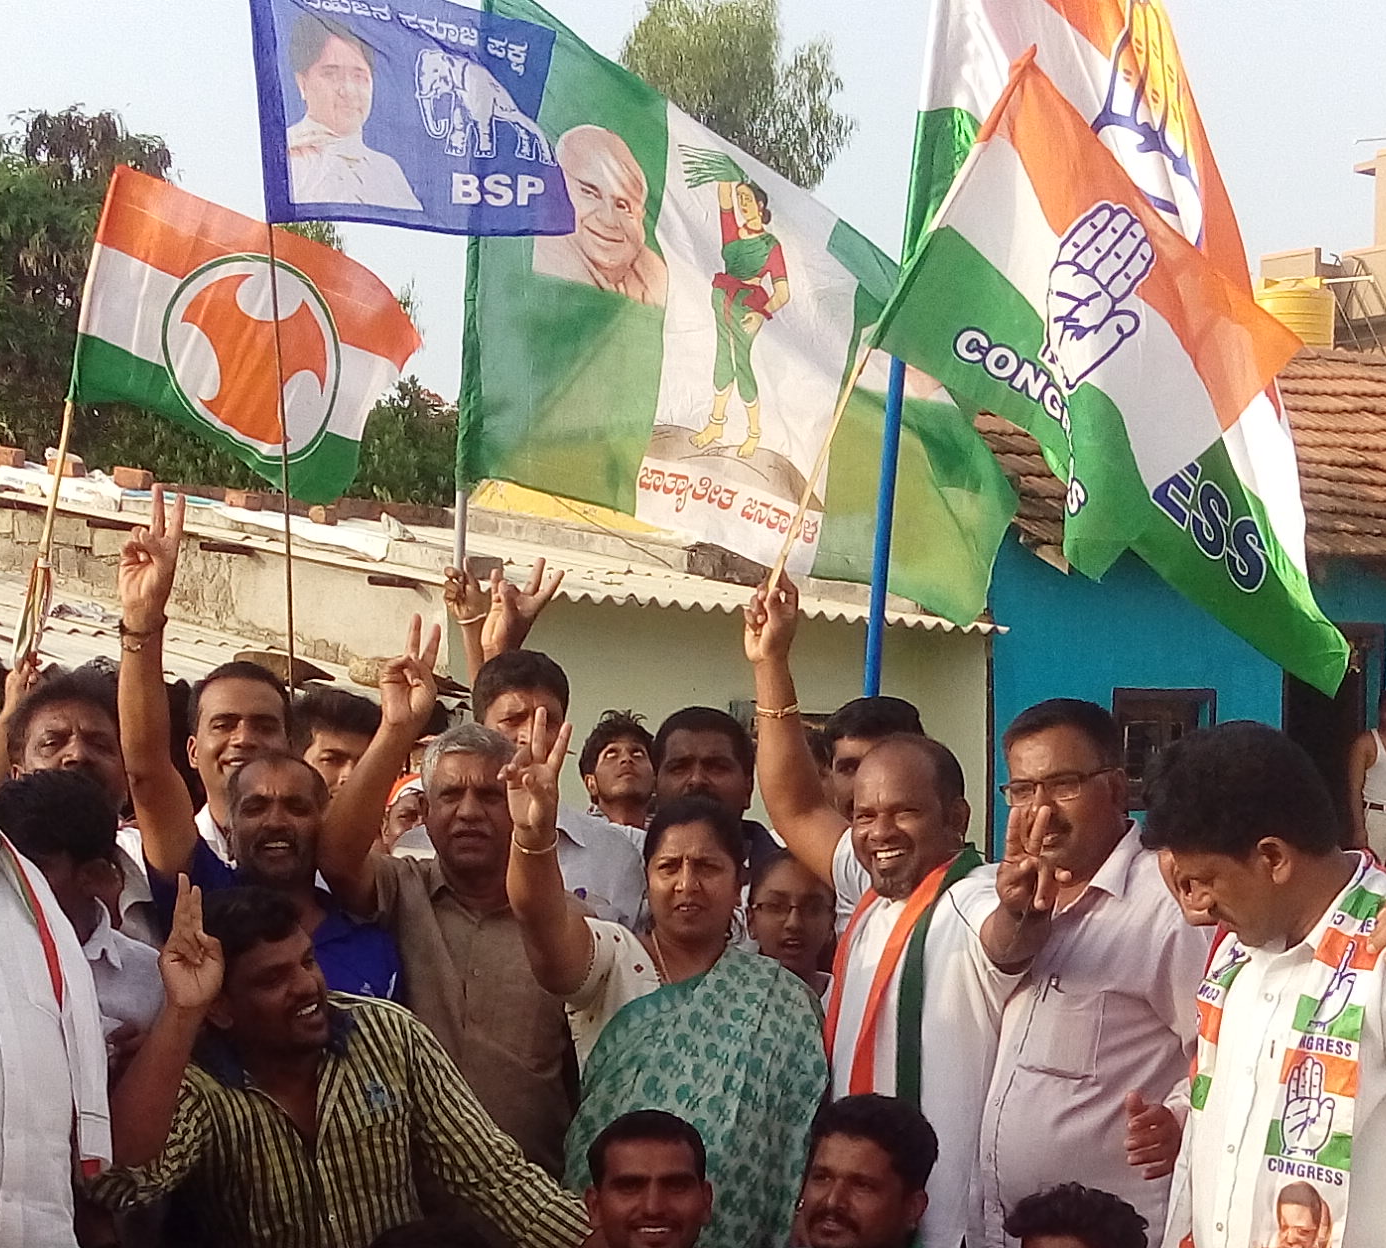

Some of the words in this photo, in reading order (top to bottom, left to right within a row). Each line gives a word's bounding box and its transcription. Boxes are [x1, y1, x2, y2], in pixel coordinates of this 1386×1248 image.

[397, 12, 479, 47] ಸಮಾಜ
[451, 172, 545, 208] BSP
[1297, 1035, 1353, 1067] NGRESS
[1266, 1157, 1345, 1187] CONGRESS
